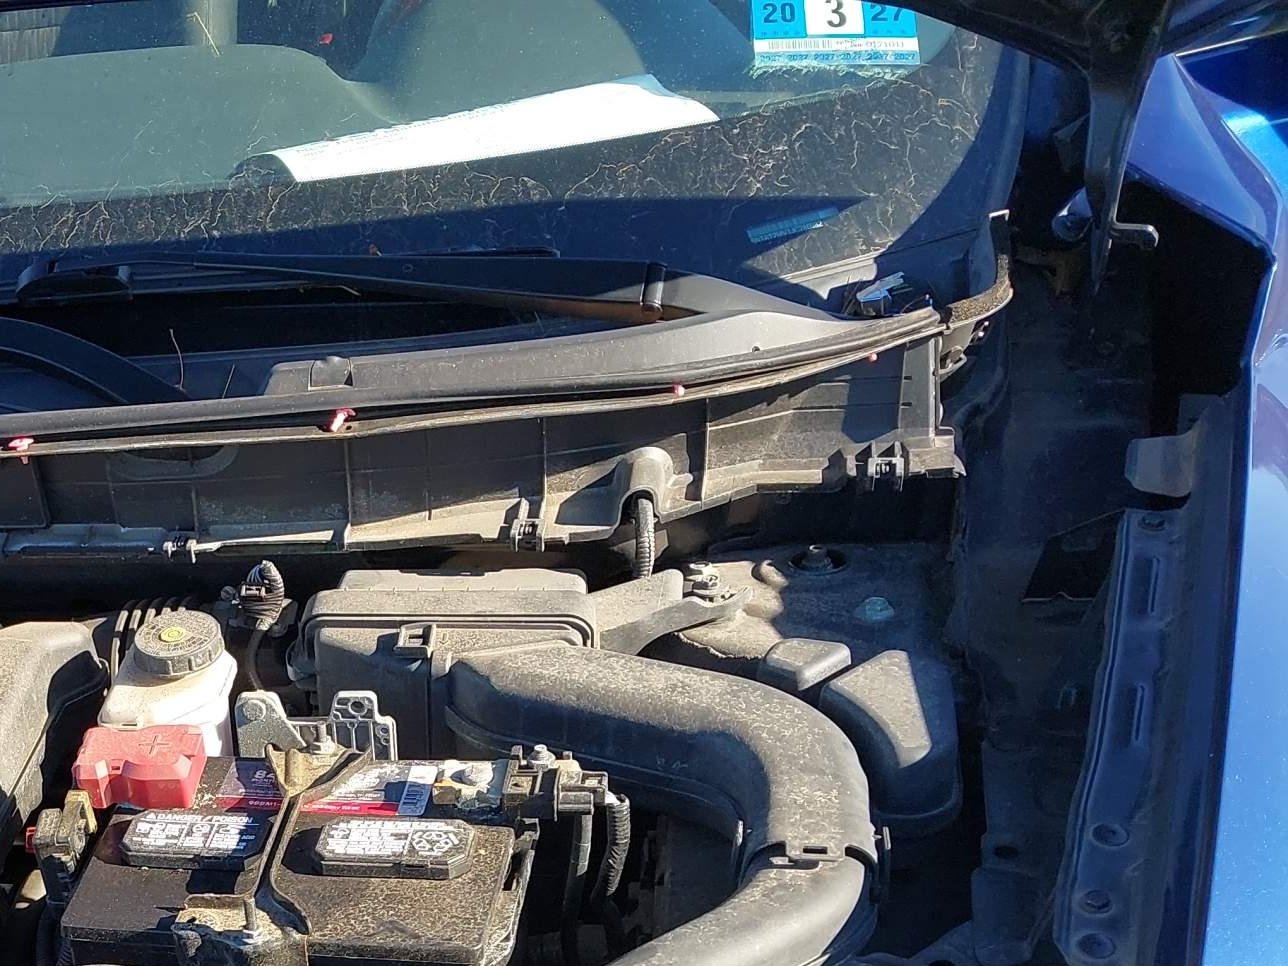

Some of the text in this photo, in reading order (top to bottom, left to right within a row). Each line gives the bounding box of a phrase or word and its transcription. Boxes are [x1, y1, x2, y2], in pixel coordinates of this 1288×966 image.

[763, 0, 904, 28] 20 3 27
[157, 812, 201, 822] DANGER
[212, 815, 253, 823] POISON
